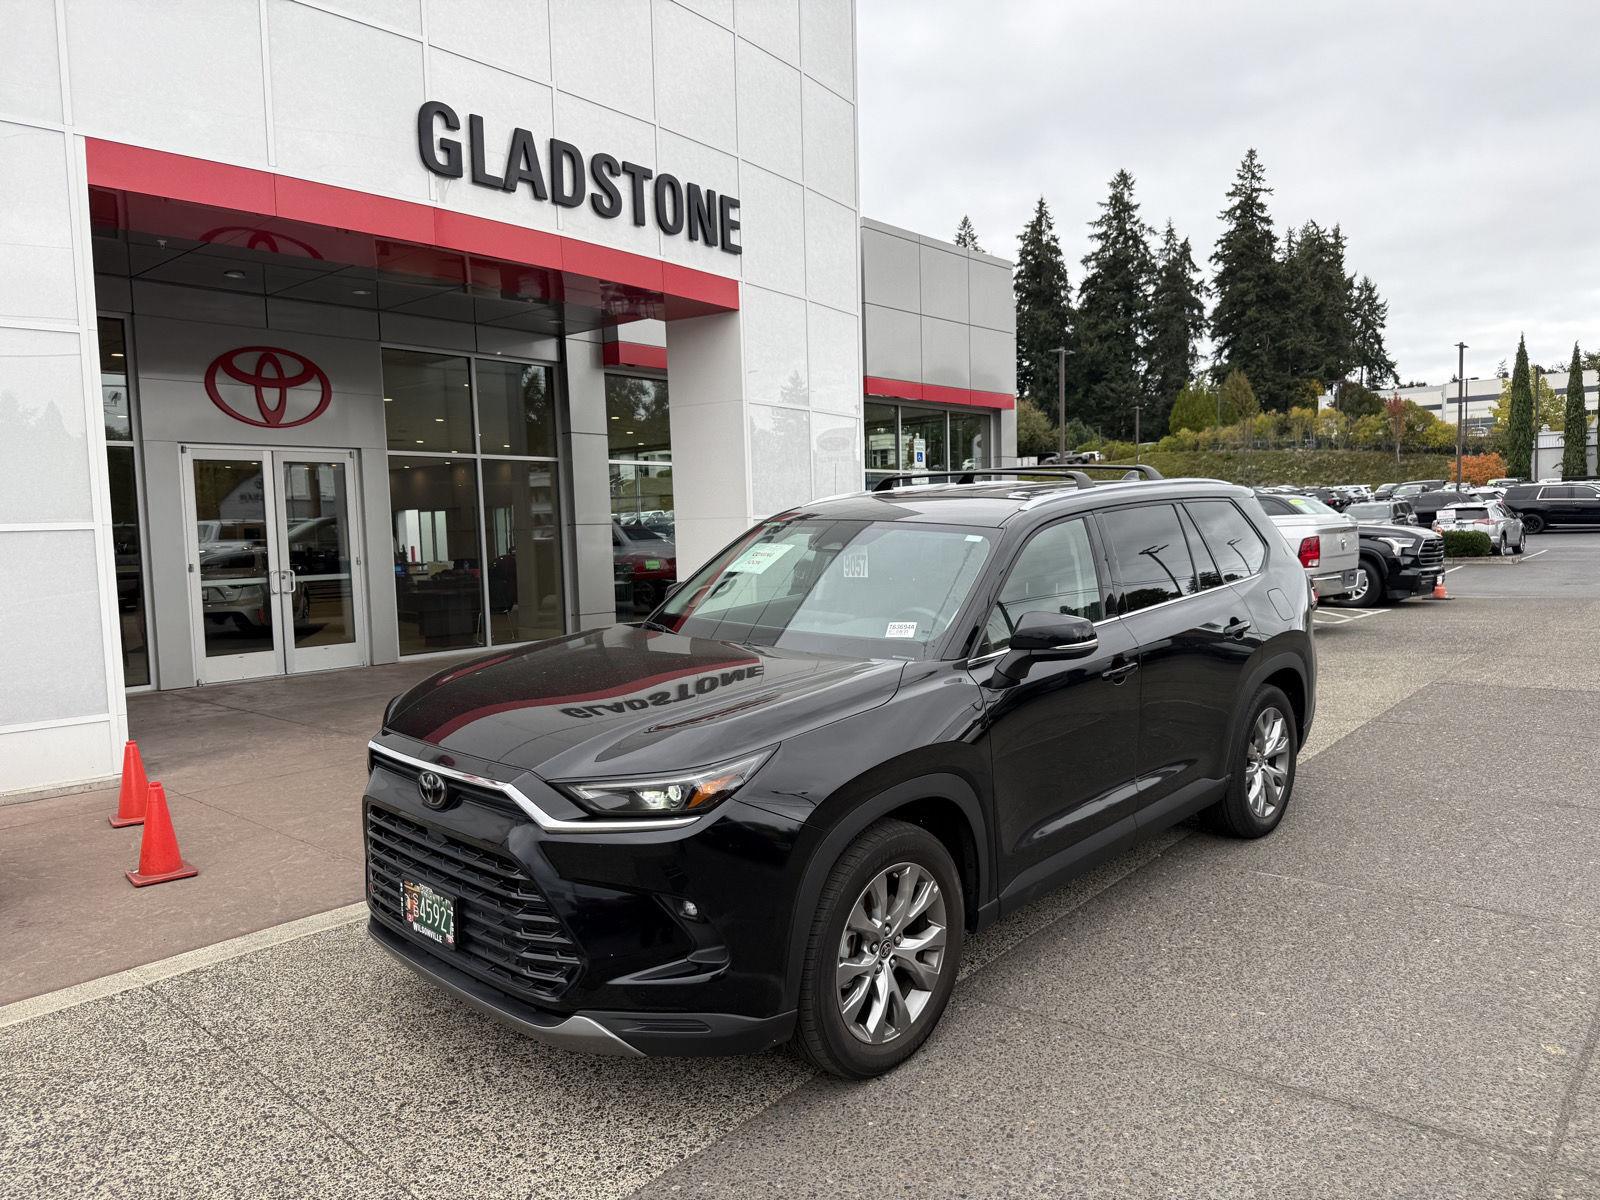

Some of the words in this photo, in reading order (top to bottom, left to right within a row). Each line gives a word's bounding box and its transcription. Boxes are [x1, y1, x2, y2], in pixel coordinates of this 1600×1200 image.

[418, 101, 742, 254] GLADSTONE
[844, 555, 866, 576] 9057
[413, 921, 443, 944] WILSONVILLE
